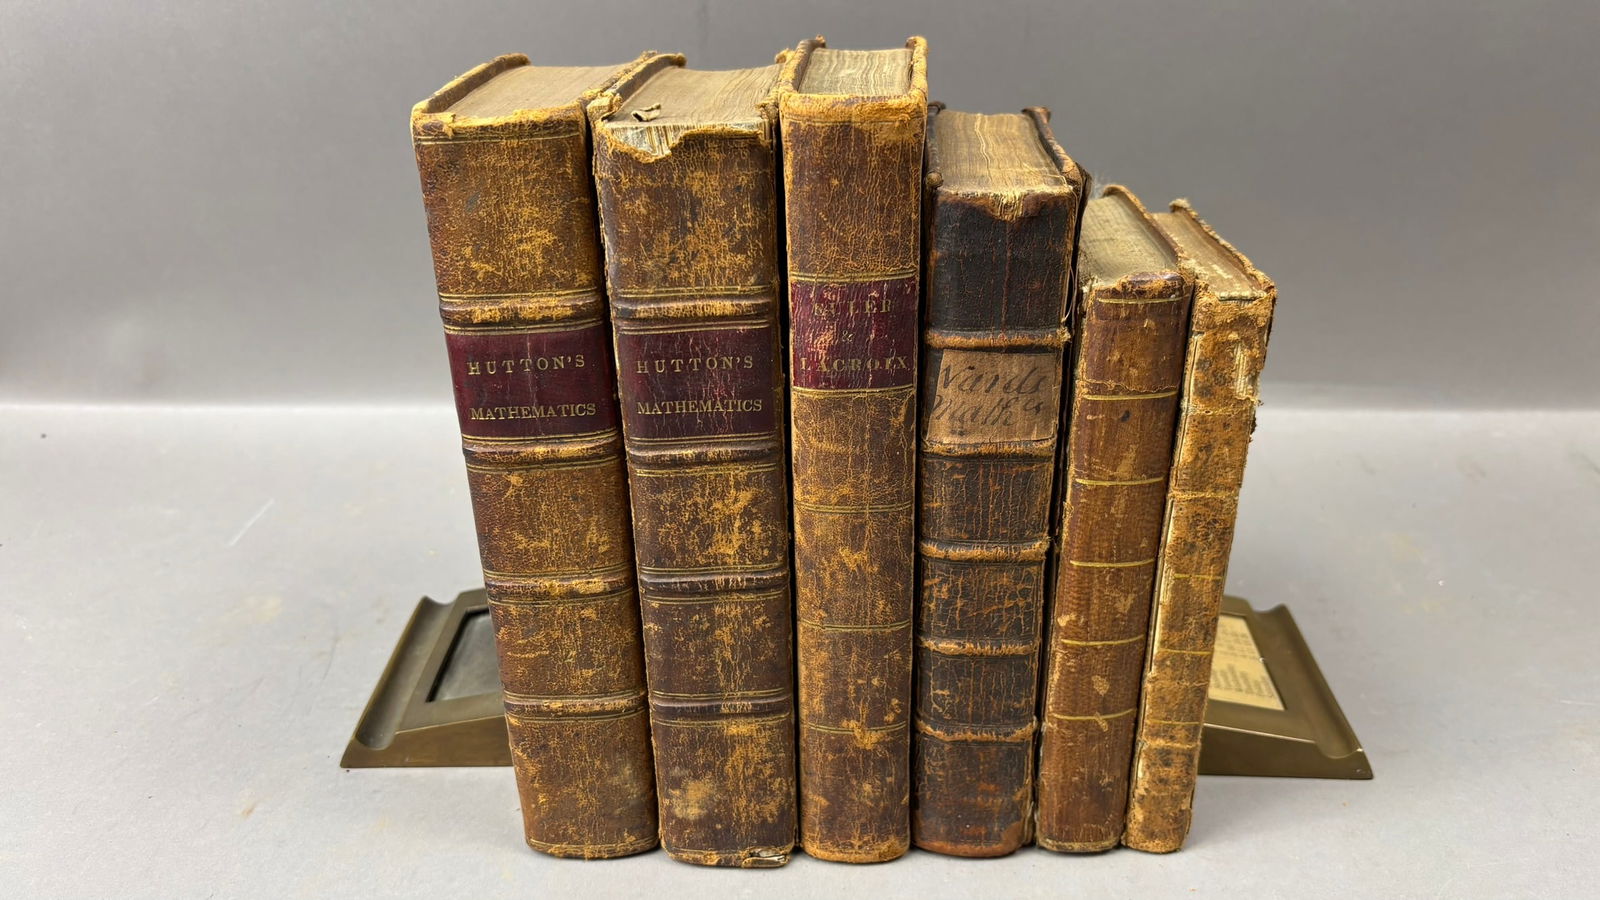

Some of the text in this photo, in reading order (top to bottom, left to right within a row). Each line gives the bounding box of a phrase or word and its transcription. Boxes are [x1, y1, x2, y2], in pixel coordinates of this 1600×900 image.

[842, 330, 854, 343] &
[466, 354, 585, 375] HUTTON'S
[636, 355, 753, 374] HUTTON'S
[470, 403, 597, 420] MATHEMATICS
[636, 399, 763, 415] MATHEMATICS
